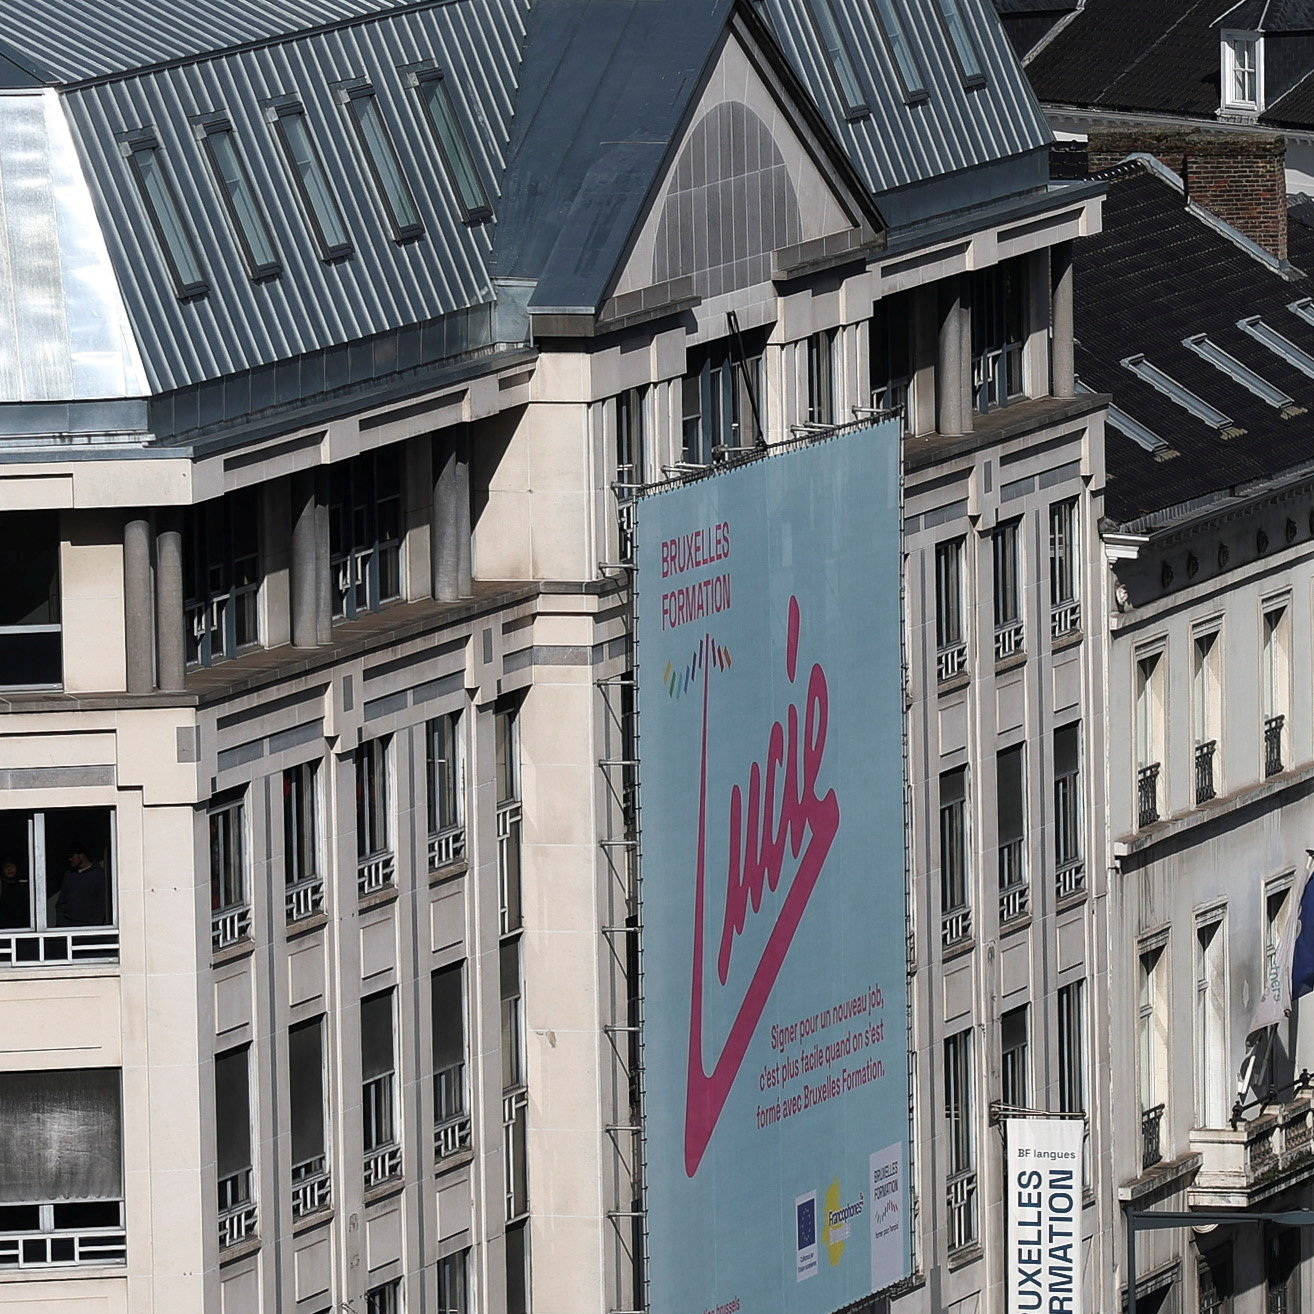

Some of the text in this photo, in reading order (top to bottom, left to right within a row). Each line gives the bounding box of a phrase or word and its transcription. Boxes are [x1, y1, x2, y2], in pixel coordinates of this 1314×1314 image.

[662, 521, 730, 578] BRUXELLES
[662, 573, 731, 631] FORMATION
[684, 595, 840, 1178] Lucie
[771, 982, 884, 1053] Signer pour un nouveau job,
[759, 1019, 884, 1092] c'est plus facile quand on s'est
[757, 1057, 885, 1130] formé avec Bruxelles Formation.
[874, 1161, 898, 1183] BRUXELLES
[1018, 1149, 1076, 1161] BF langues
[829, 1203, 862, 1226] Francophones
[874, 1179, 898, 1201] FORMATION
